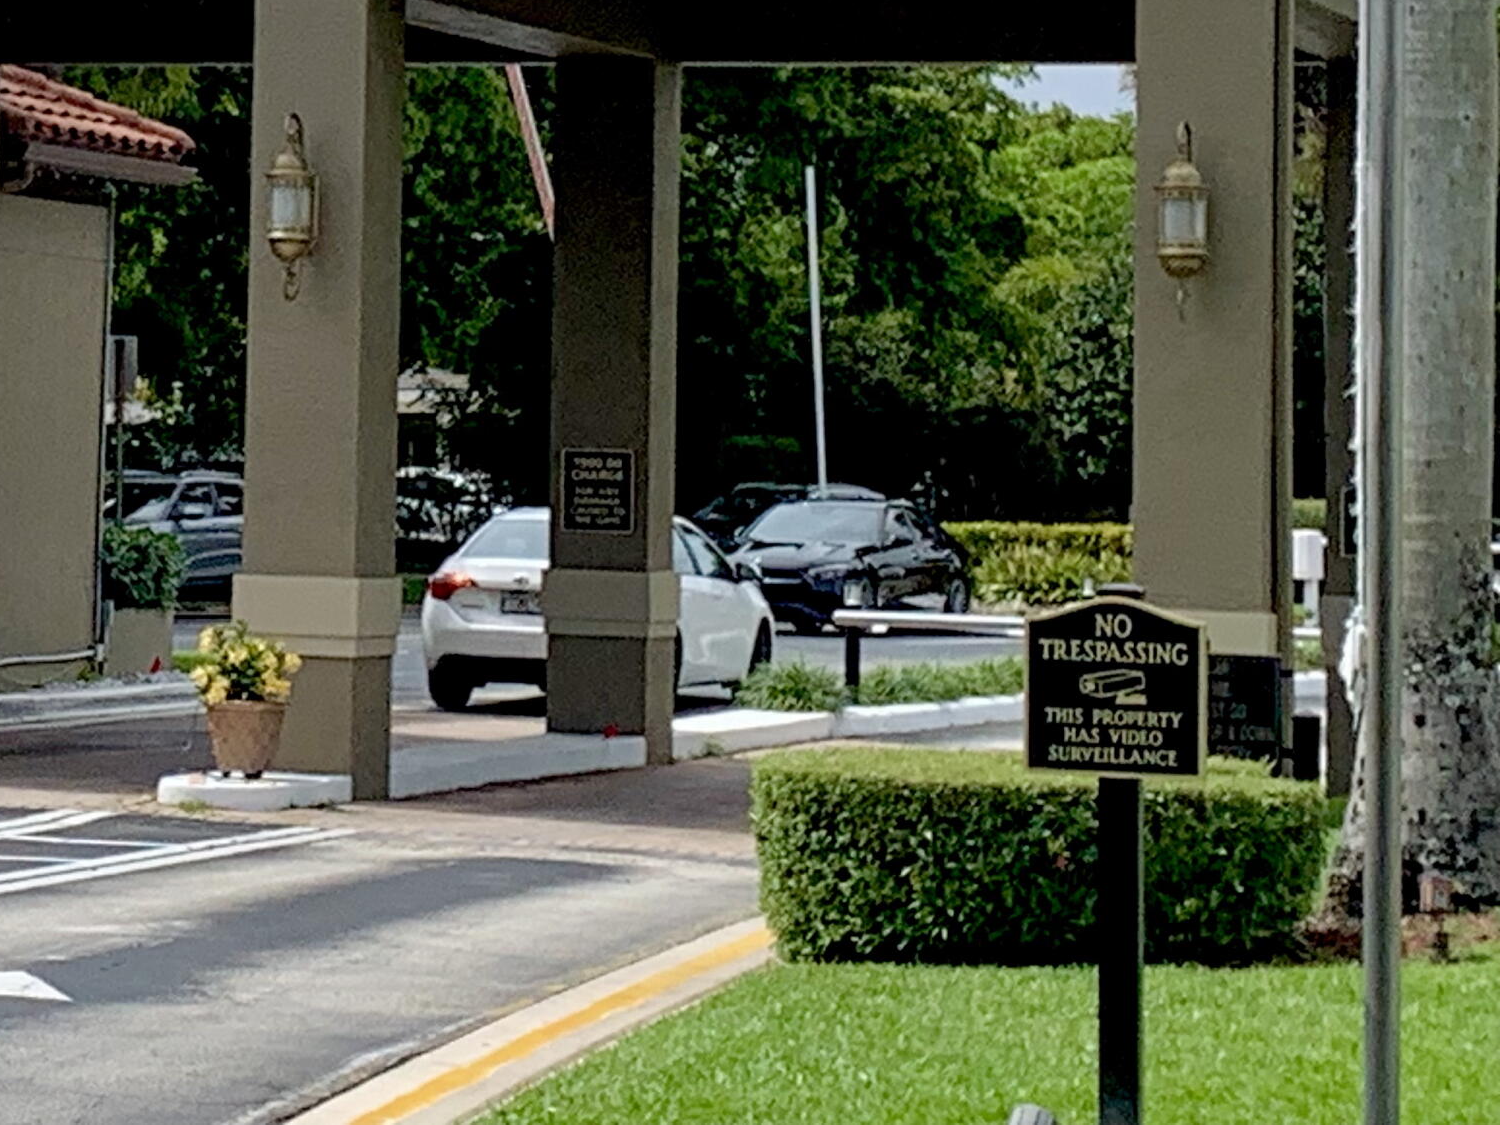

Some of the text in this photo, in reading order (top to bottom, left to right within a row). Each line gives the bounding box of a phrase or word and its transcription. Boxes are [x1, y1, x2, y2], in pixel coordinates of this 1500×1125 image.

[1094, 613, 1133, 639] NO
[1038, 638, 1189, 666] TRESPASSING
[1043, 706, 1184, 729] THIS PROPERTY
[1063, 726, 1164, 747] HAS VIDEO
[1048, 744, 1179, 767] SURVEILLANCE
